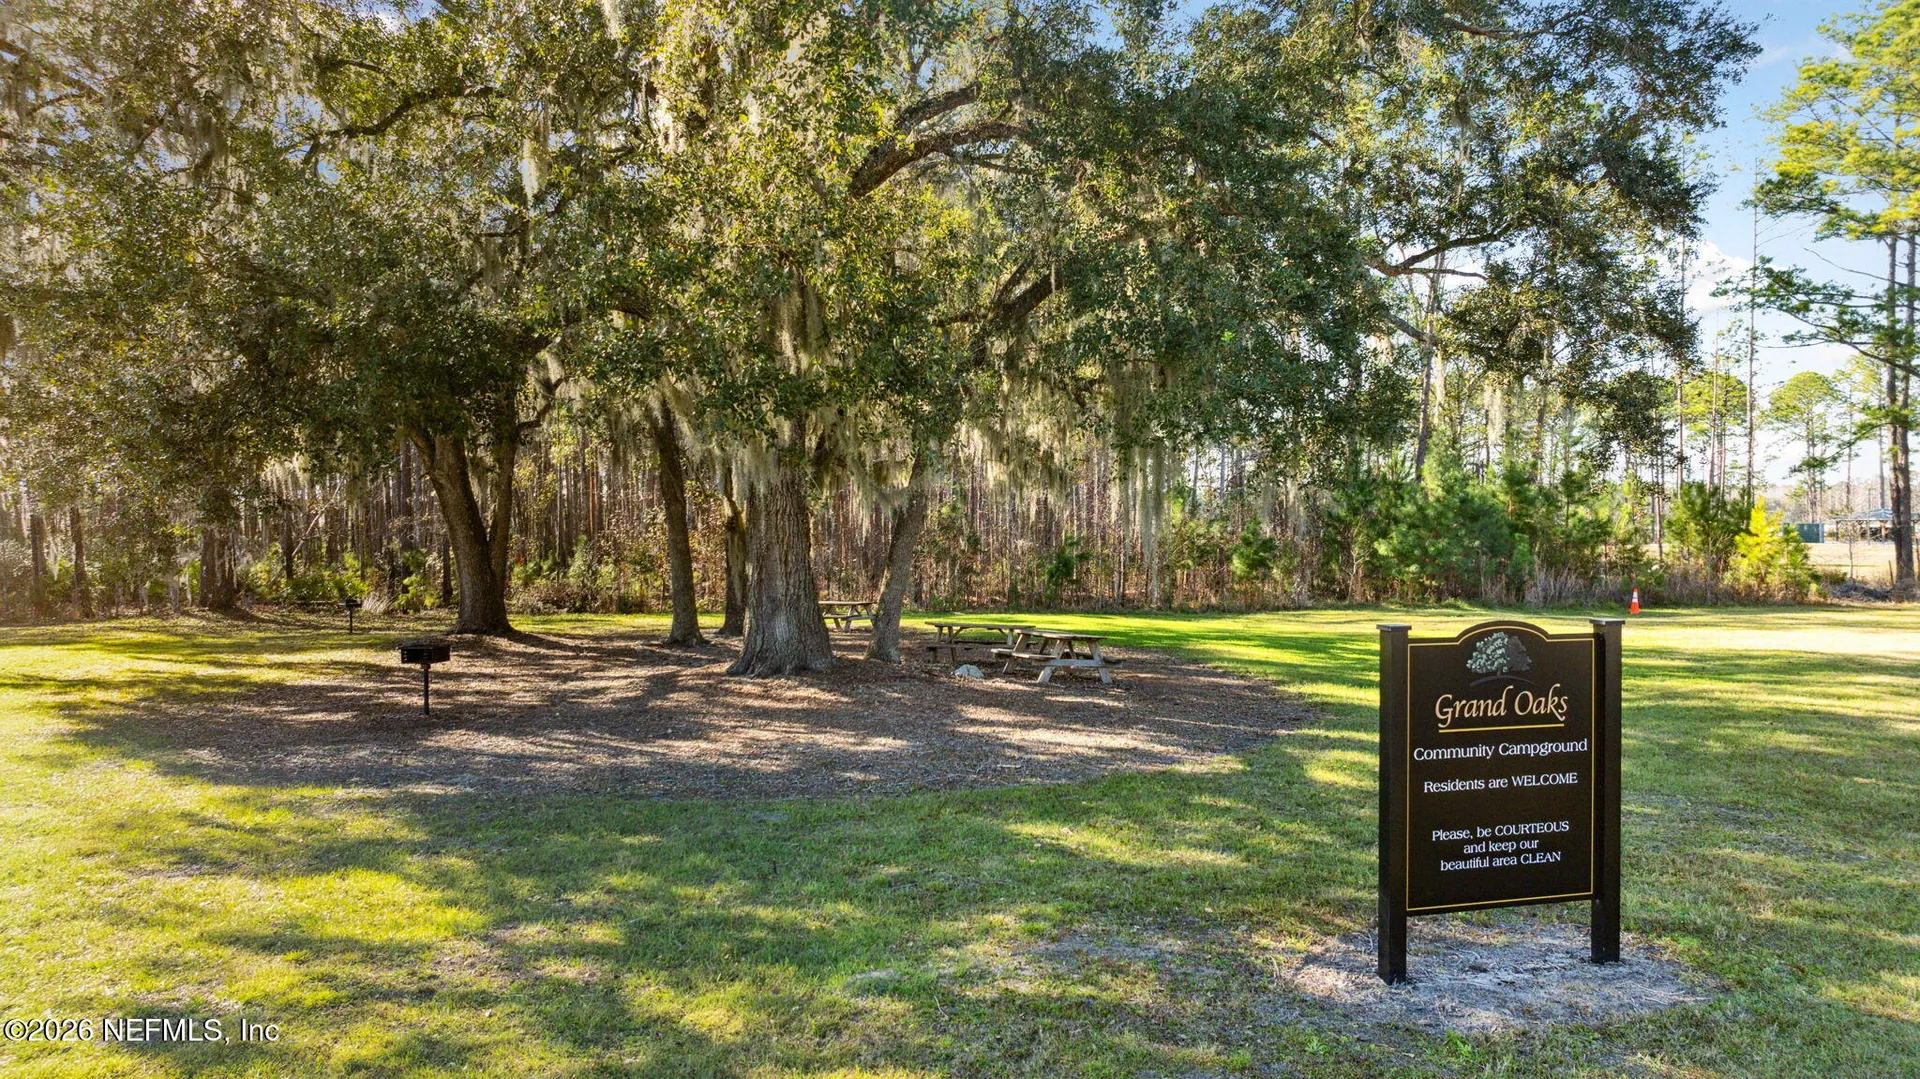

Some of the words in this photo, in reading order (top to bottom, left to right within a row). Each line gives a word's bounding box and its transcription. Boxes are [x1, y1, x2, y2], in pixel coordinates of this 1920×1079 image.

[1435, 684, 1513, 728] Grand
[1514, 683, 1568, 722] Oaks
[1414, 744, 1495, 761] Community
[1499, 738, 1588, 757] Campground
[1424, 777, 1484, 793] Residents
[1488, 776, 1508, 789] are
[1512, 772, 1577, 786] WELCOME
[1432, 828, 1473, 841] Please,
[1477, 826, 1491, 837] be
[1495, 821, 1569, 835] COURTEOUS
[1464, 840, 1485, 853] and
[1489, 839, 1516, 853] keep
[1520, 838, 1538, 850] our
[1440, 857, 1489, 871] beautiful
[1493, 856, 1517, 867] area
[1521, 851, 1561, 864] CLEAN
